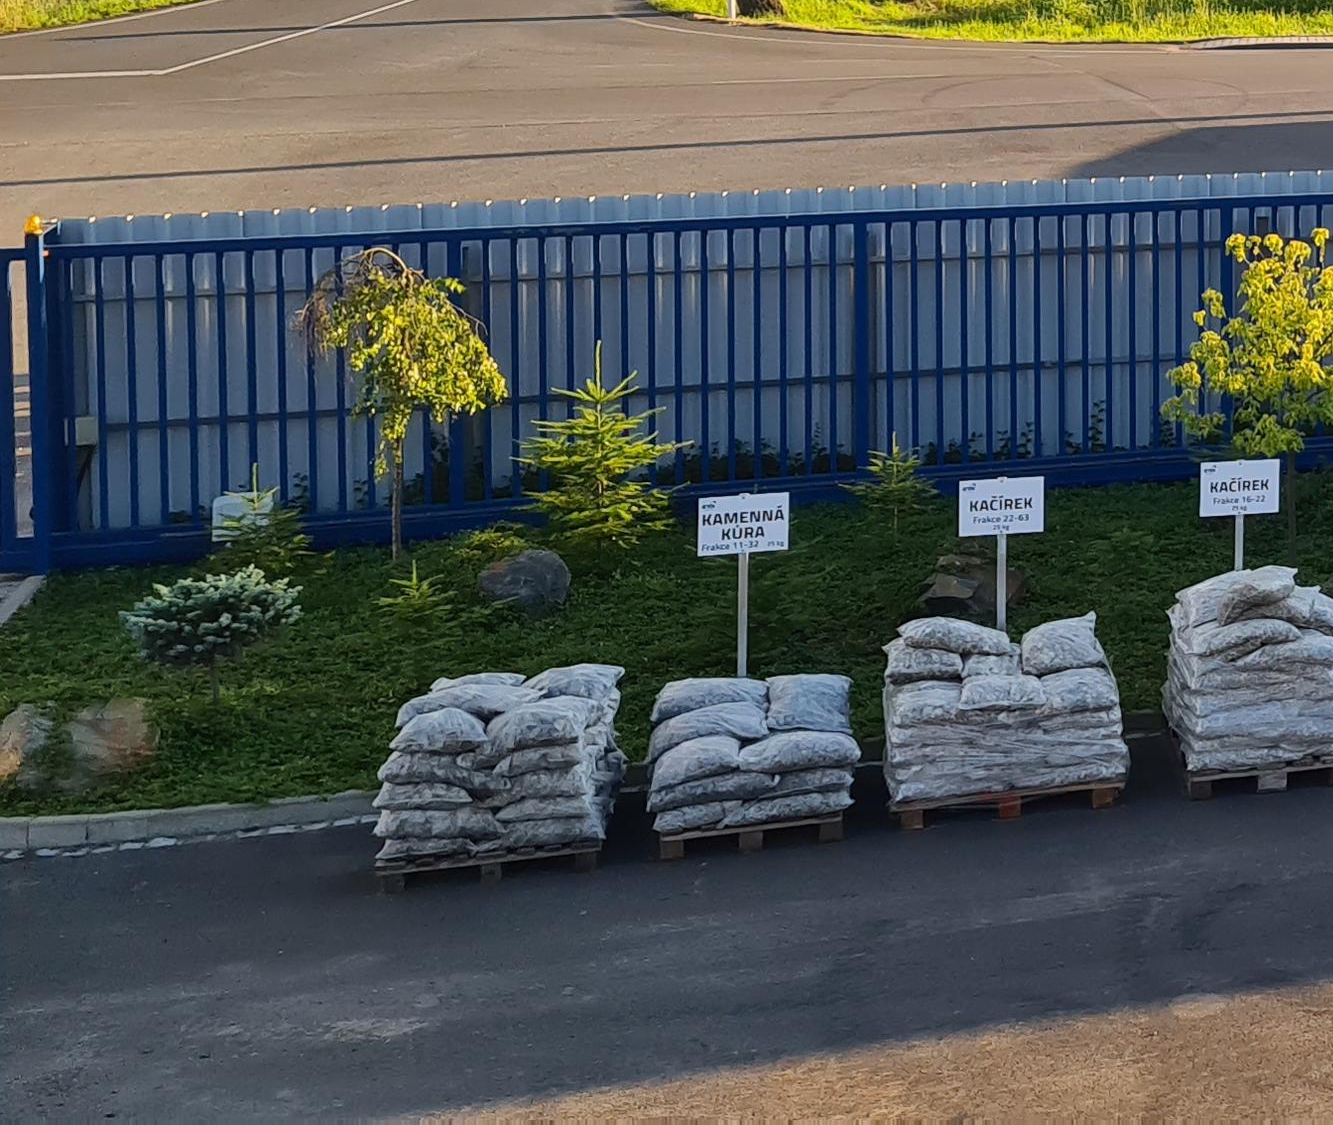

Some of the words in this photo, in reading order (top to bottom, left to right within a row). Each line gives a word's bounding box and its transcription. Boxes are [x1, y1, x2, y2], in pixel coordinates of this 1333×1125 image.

[1210, 477, 1269, 493] KAČÍREK
[969, 495, 1033, 512] KAČÍREK
[702, 505, 785, 526] KAMENNÁ
[972, 515, 1001, 524] Frakce
[721, 524, 765, 541] KŮRA
[701, 543, 730, 552] Frakce
[733, 540, 759, 549] 11-32
